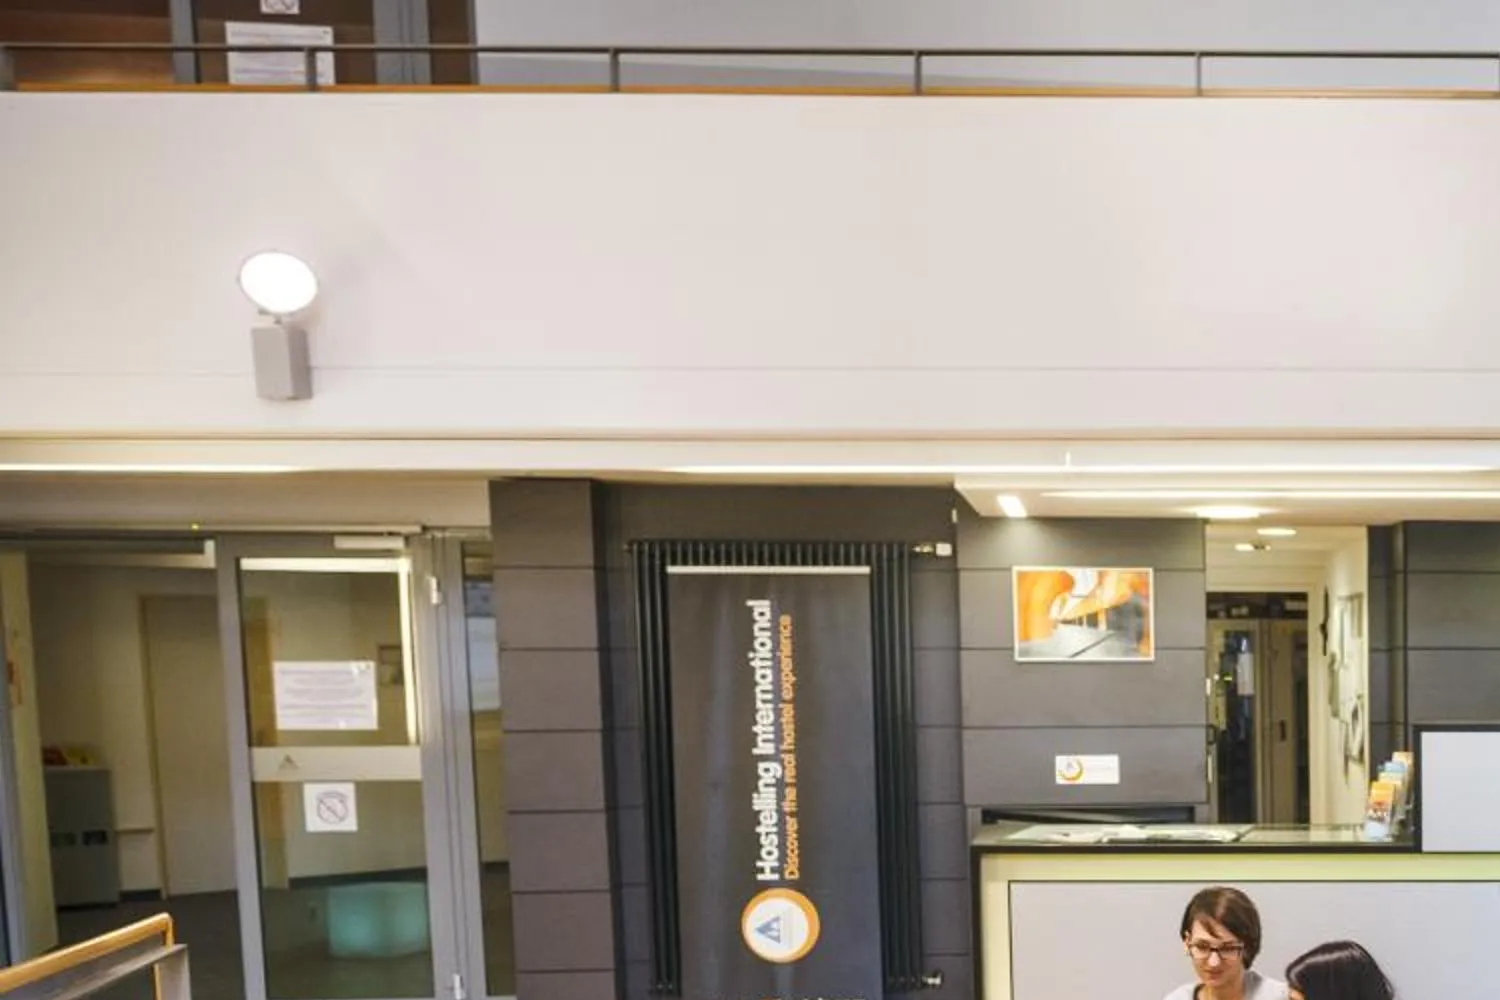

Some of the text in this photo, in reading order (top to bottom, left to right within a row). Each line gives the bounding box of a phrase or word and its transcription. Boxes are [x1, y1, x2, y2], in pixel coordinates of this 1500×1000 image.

[745, 599, 783, 881] Hostelling International
[775, 615, 800, 880] Discover the real hostel experience
